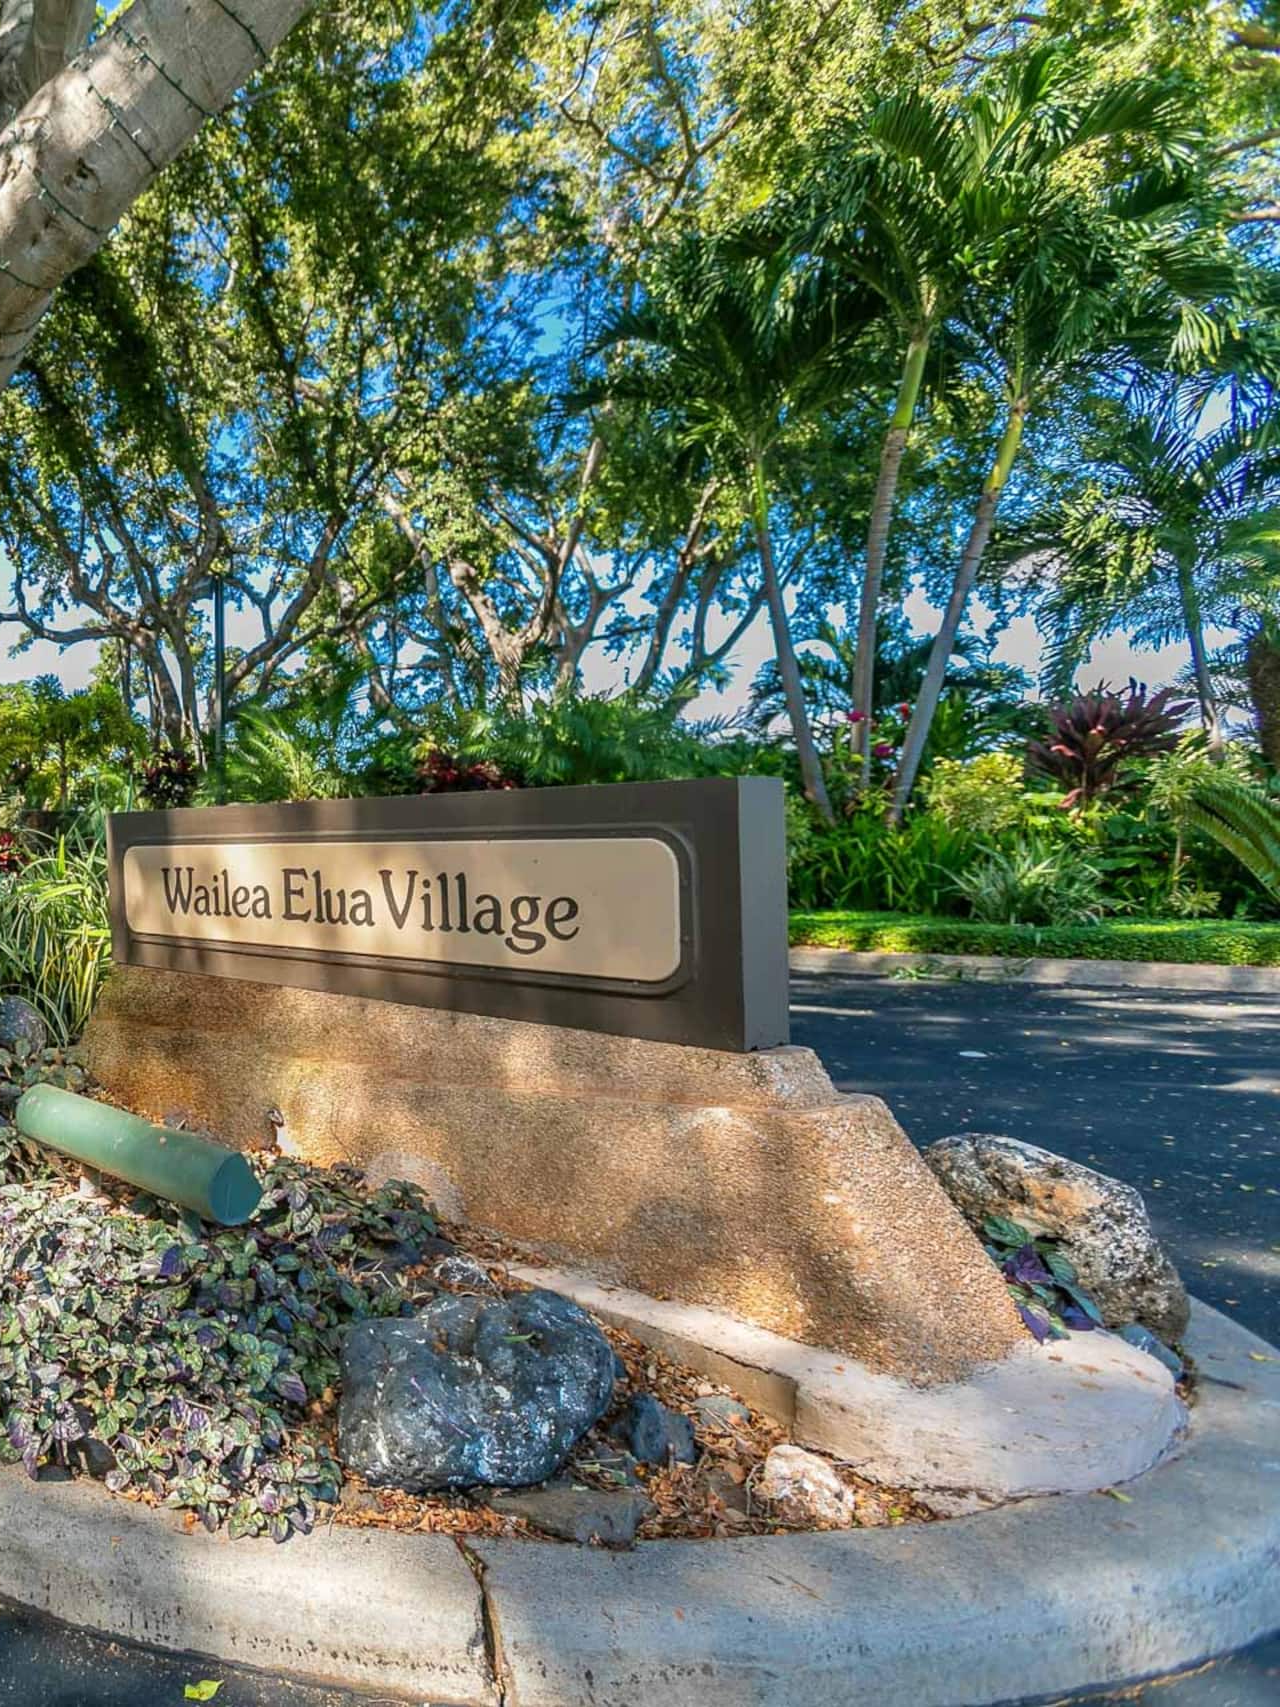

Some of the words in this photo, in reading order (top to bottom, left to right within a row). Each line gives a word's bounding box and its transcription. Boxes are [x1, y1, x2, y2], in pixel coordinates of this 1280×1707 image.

[161, 867, 272, 919] Wailea
[281, 867, 375, 926] Elua
[378, 869, 579, 955] Village
